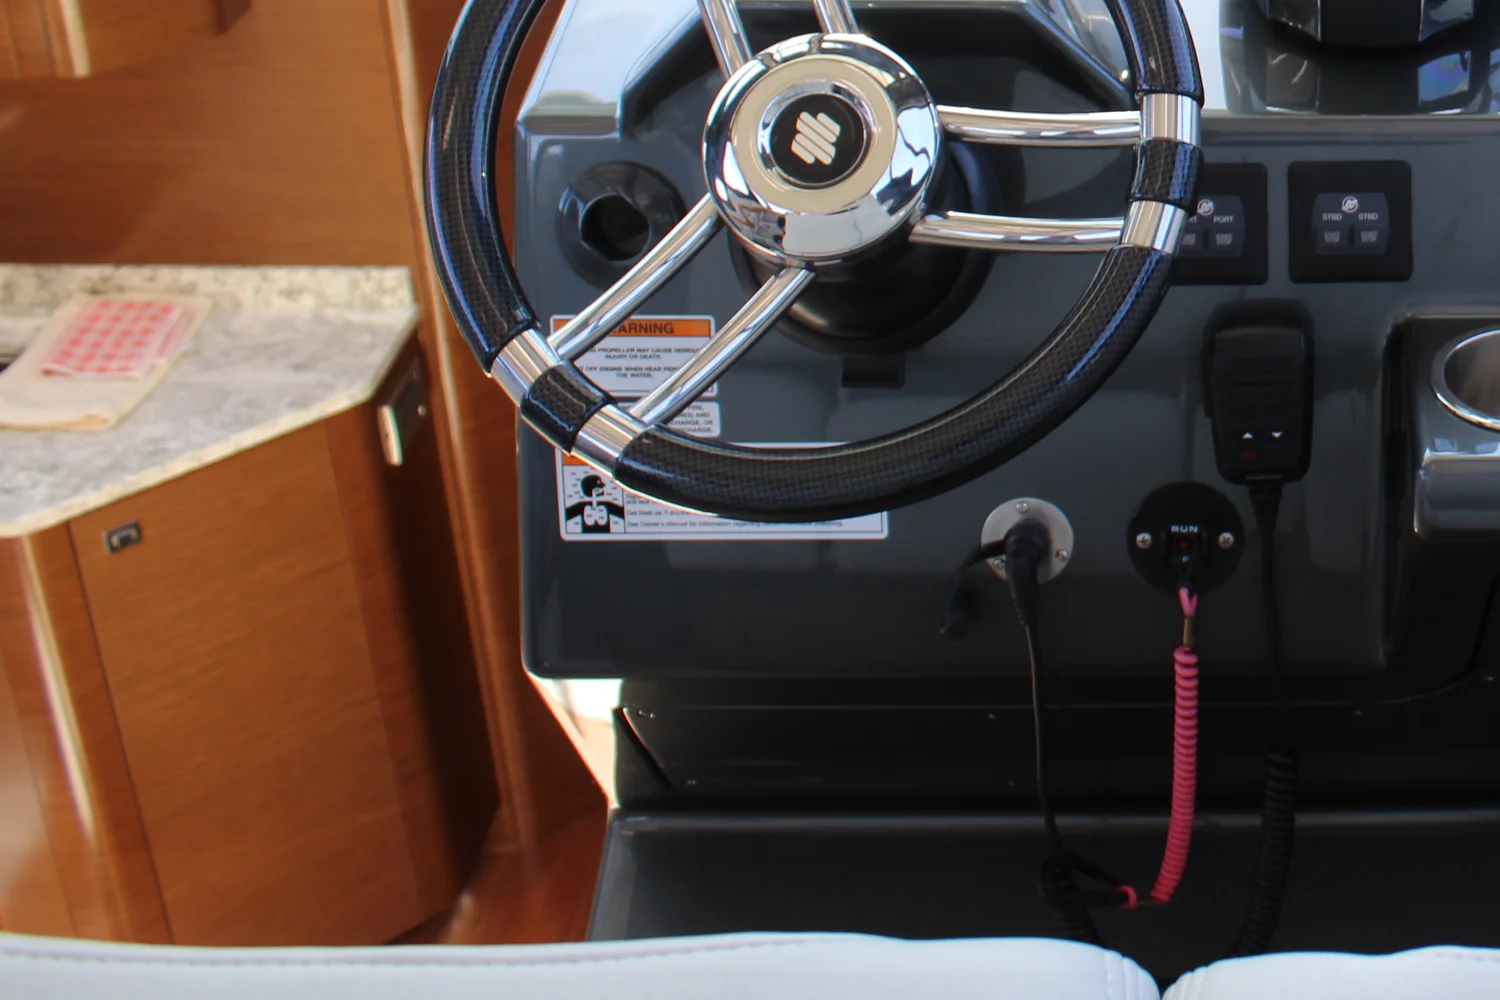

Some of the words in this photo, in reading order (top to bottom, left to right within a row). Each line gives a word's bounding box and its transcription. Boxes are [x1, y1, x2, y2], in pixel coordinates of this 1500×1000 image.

[1213, 214, 1234, 224] PORT
[1322, 212, 1343, 221] STBD
[1358, 212, 1379, 221] STBD
[614, 322, 675, 335] ARNING
[1171, 524, 1199, 534] RUN
